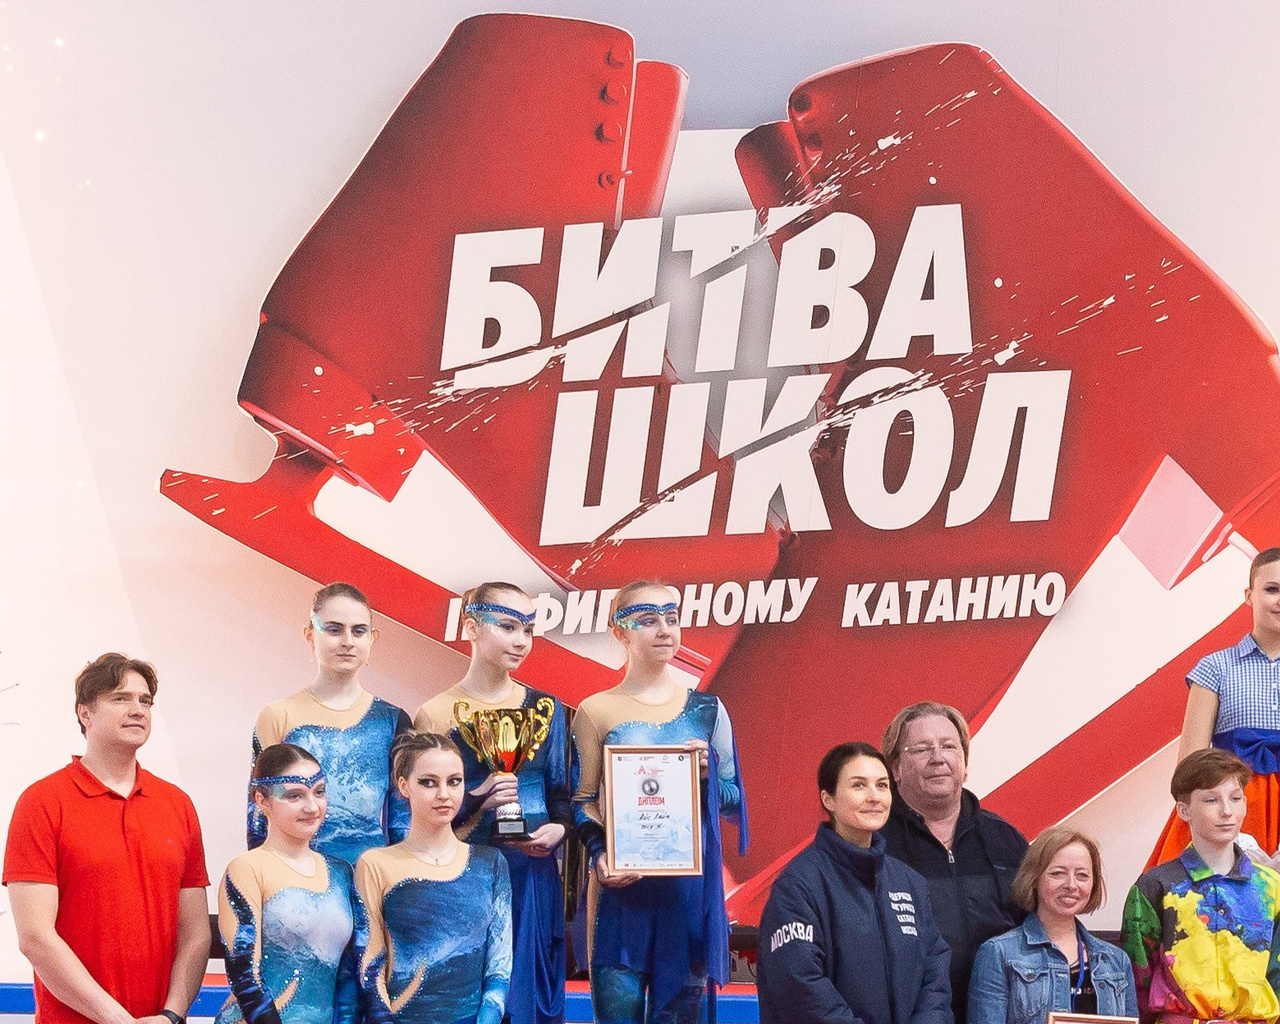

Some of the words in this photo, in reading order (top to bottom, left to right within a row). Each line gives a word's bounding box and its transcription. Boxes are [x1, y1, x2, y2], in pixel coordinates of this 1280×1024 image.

[440, 203, 973, 390] БИТВА
[538, 367, 1072, 547] ШКОЛ
[532, 577, 820, 637] ФИГНОМУ
[840, 571, 1067, 628] КАТАНИЮ
[771, 921, 814, 953] МОСКВА
